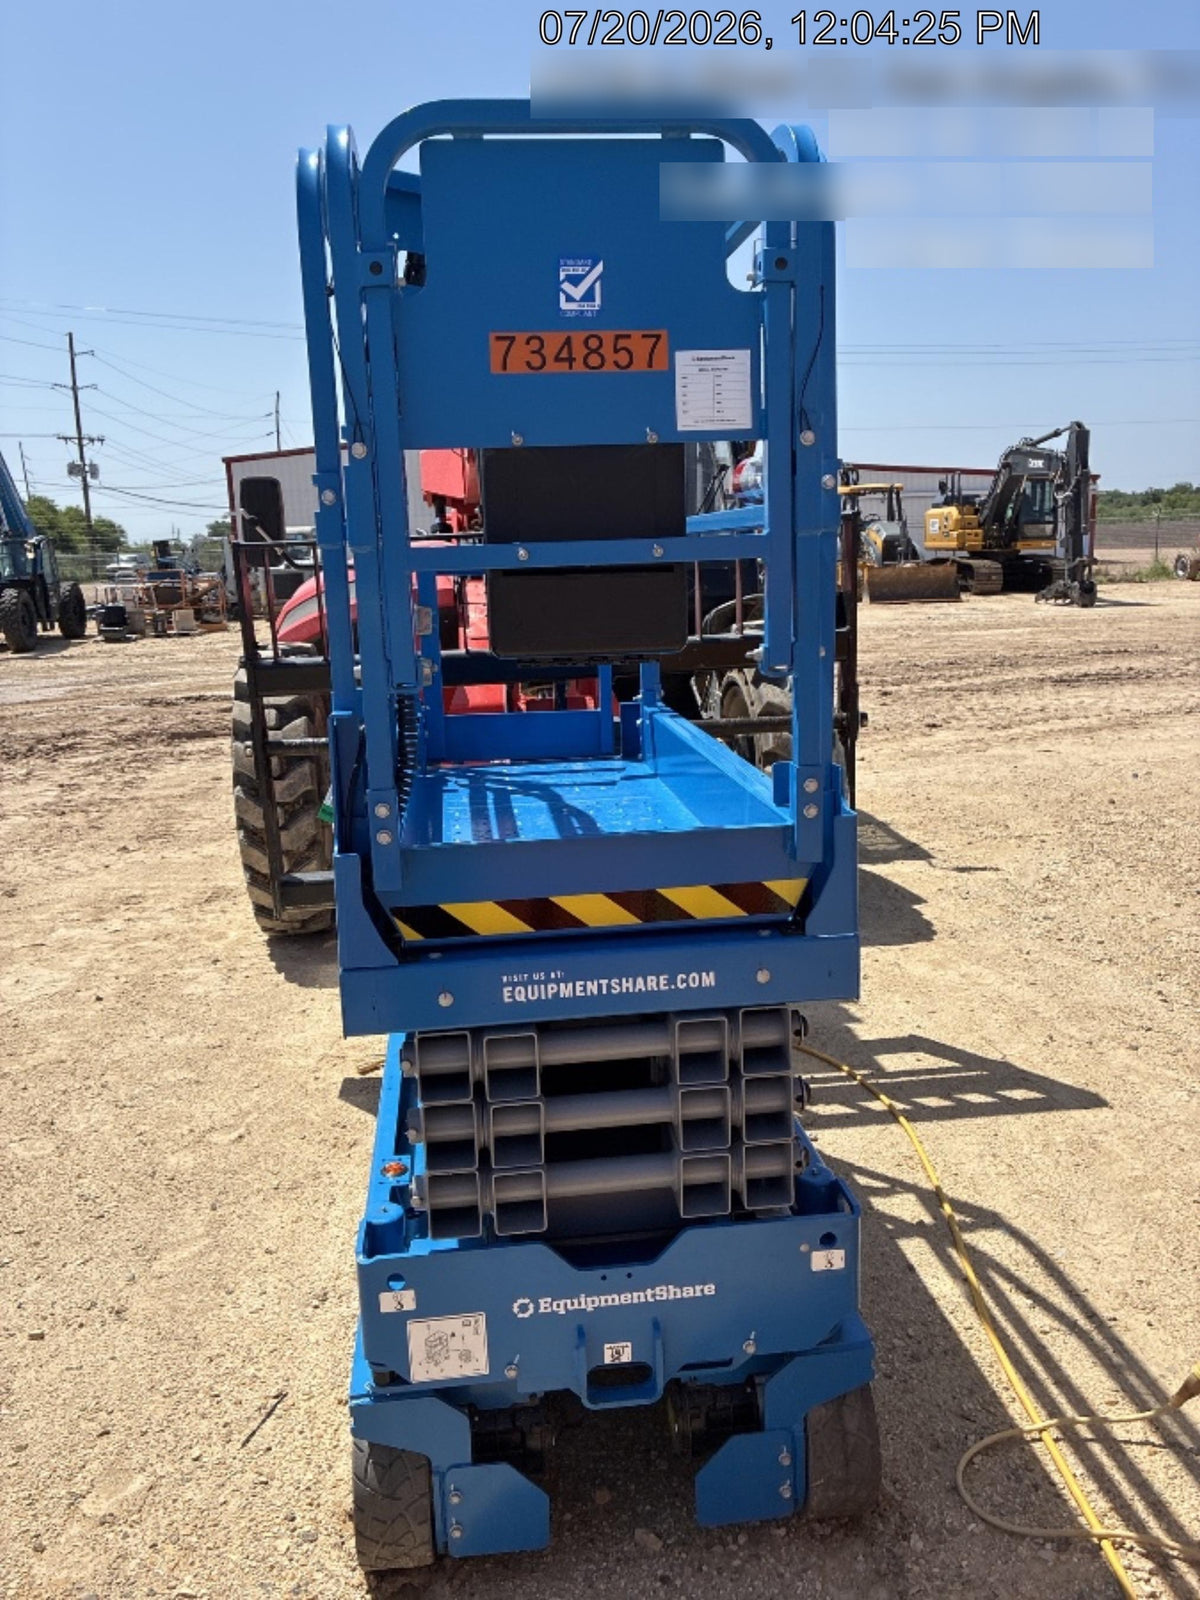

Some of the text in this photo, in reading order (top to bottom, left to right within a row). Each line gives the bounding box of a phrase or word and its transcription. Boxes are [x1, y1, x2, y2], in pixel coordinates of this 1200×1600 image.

[494, 333, 662, 371] 734857
[502, 974, 528, 983] VISIT
[533, 972, 545, 981] US
[502, 971, 716, 1003] EQUIPMENTSHARE.COM
[538, 1283, 716, 1315] EquipmentShare
